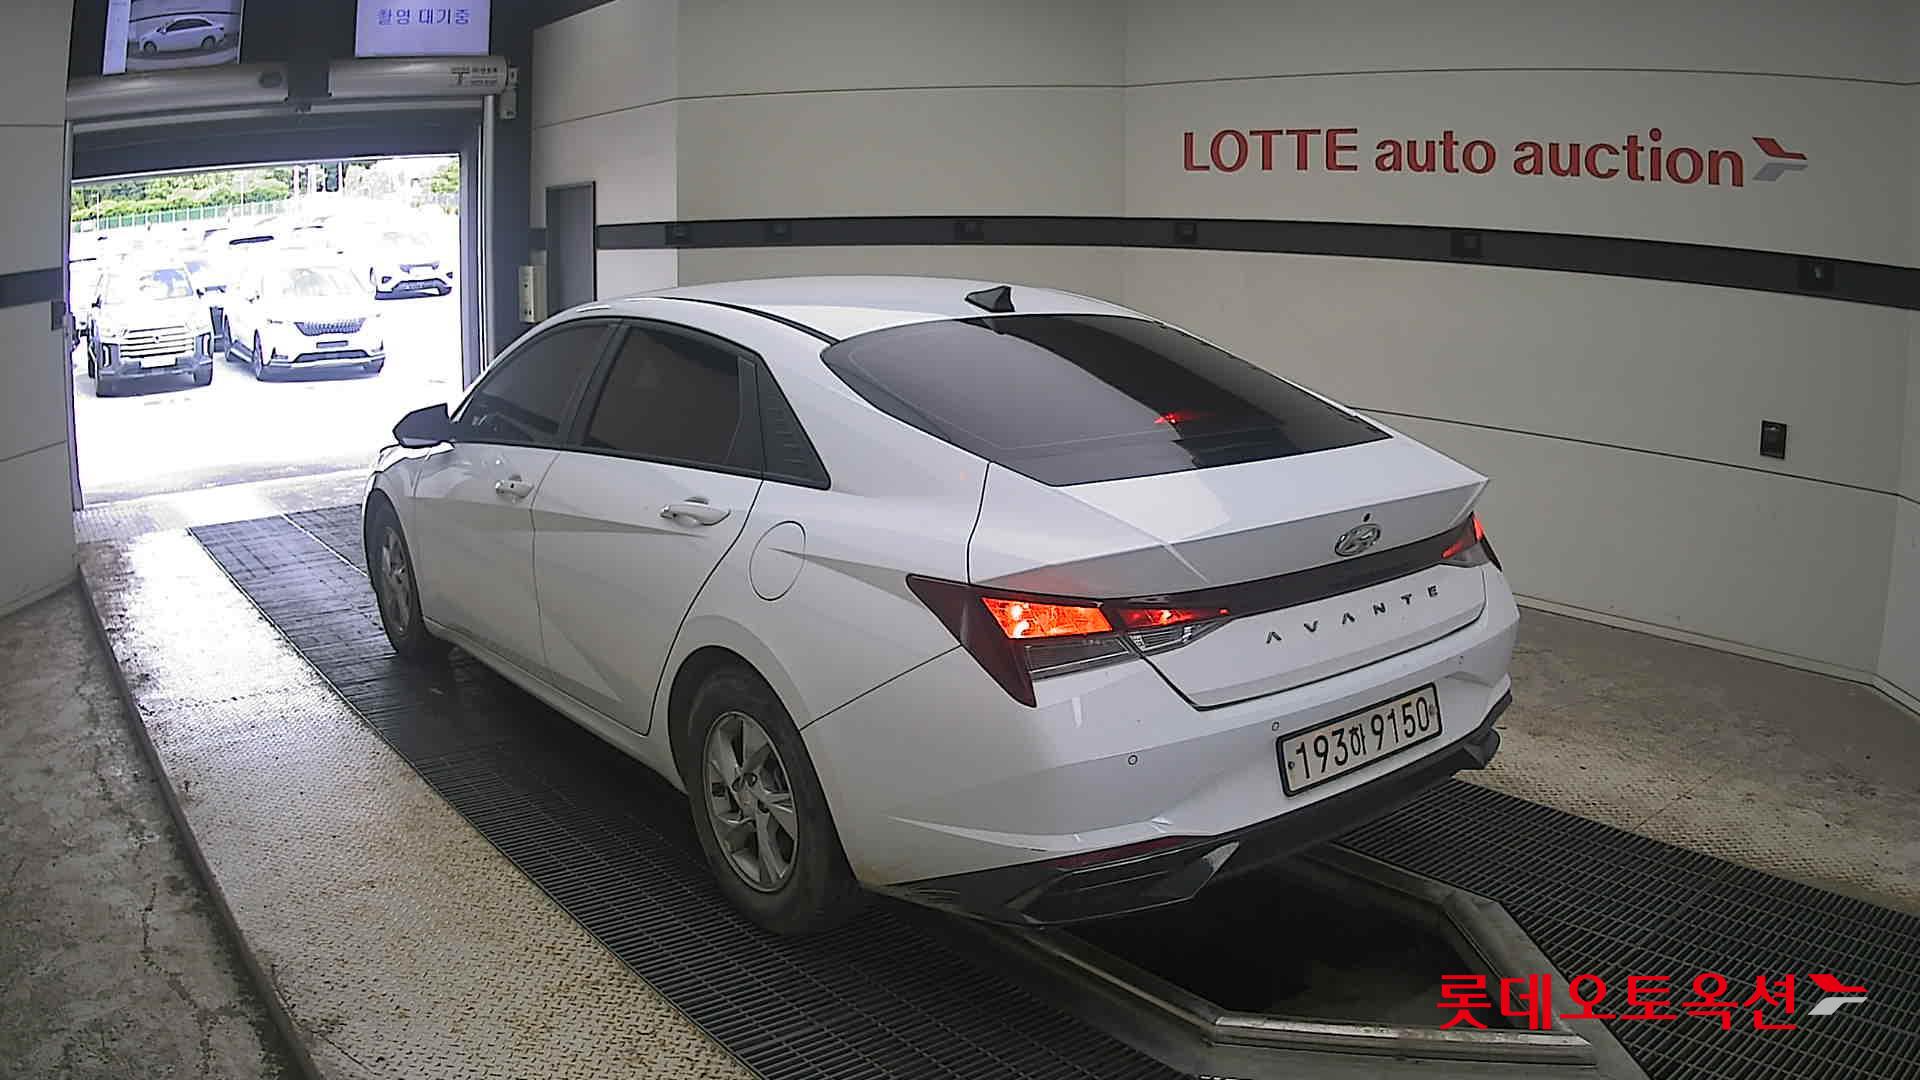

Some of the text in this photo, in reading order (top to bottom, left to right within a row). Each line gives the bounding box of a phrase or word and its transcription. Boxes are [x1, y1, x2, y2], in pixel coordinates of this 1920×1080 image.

[418, 8, 471, 25] 대기중
[1183, 127, 1744, 187] LOTTE auto auction
[1265, 584, 1439, 645] AVANTE
